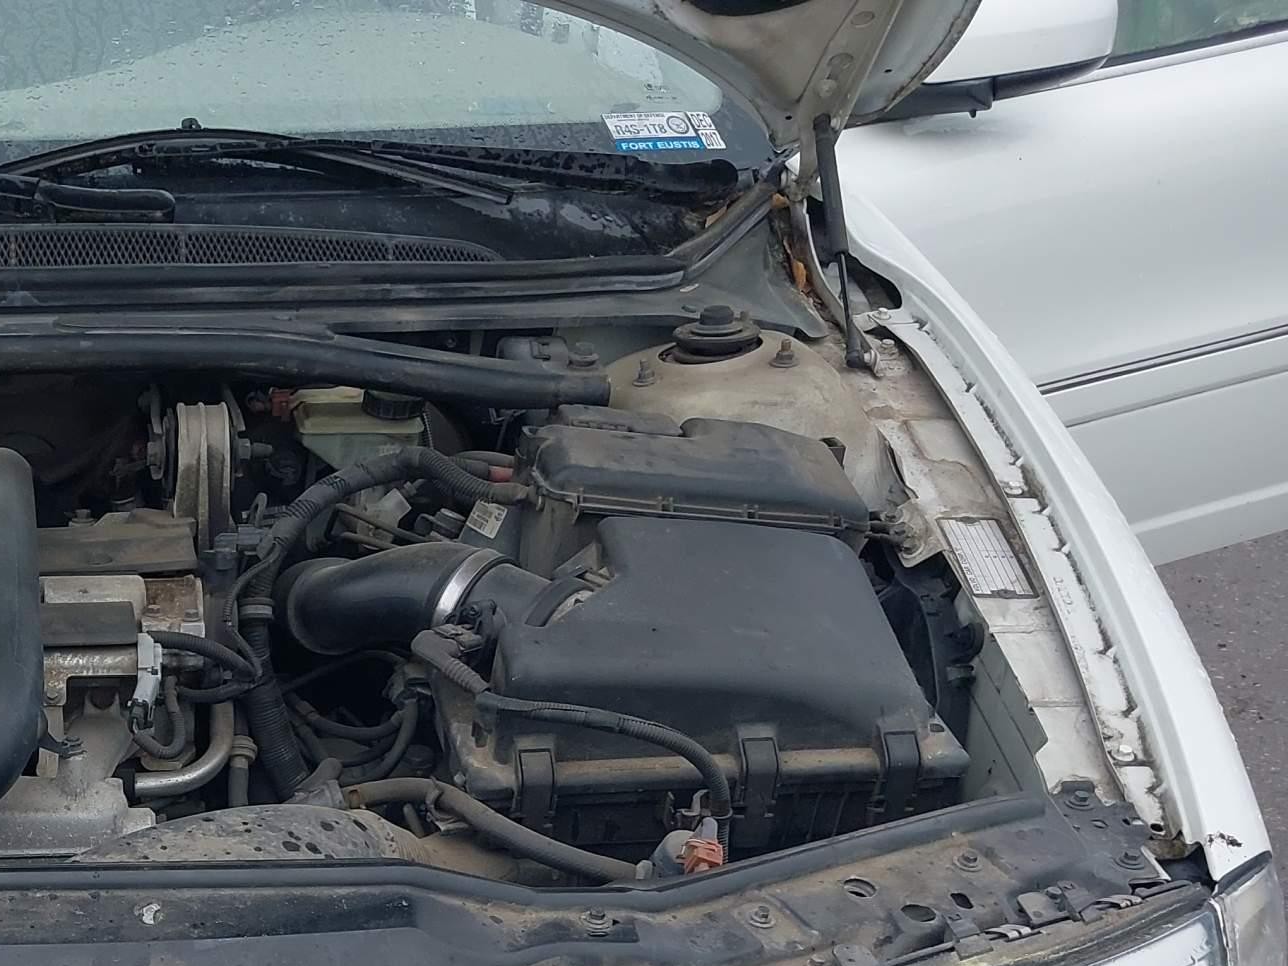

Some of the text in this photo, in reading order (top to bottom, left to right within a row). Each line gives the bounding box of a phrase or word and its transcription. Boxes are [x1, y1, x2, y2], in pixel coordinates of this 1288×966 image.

[691, 113, 712, 128] DEC
[621, 140, 700, 150] FORT EUSTIS
[700, 132, 722, 148] 2017
